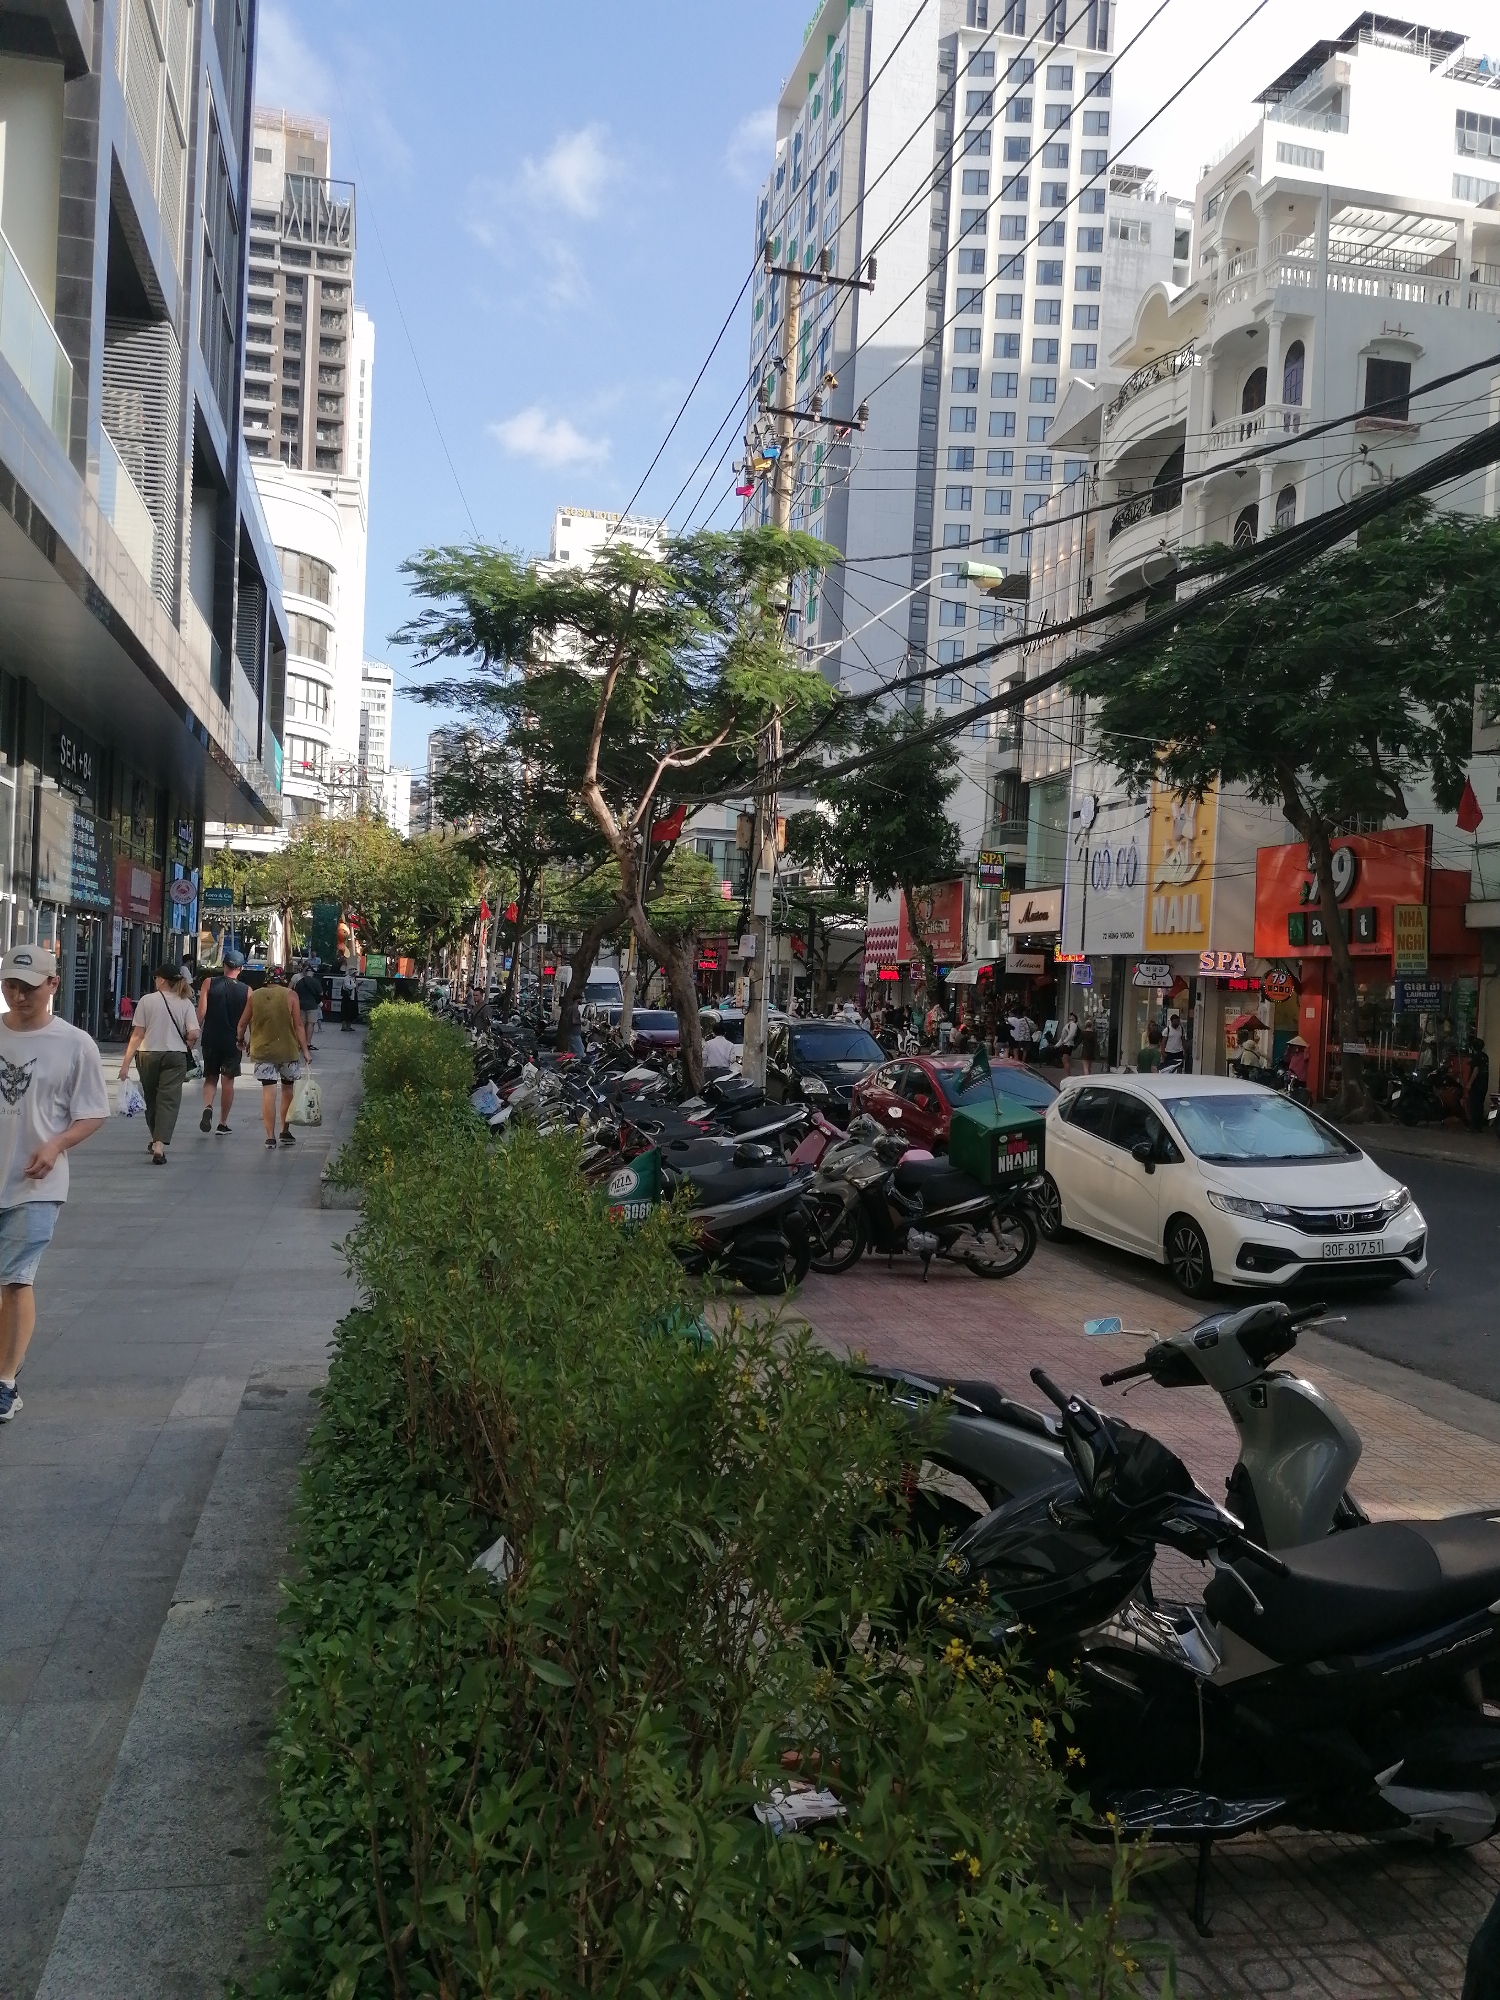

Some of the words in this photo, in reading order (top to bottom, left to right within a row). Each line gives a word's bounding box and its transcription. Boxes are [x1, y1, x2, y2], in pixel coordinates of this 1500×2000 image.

[594, 510, 621, 522] HOTEL
[60, 734, 76, 773] SEA
[79, 752, 92, 781] +84
[981, 852, 1003, 865] SPA
[1018, 901, 1049, 924] Maison
[1152, 894, 1204, 935] NAIL
[1399, 907, 1423, 928] NHÀ
[1397, 929, 1425, 951] NGHỈ
[1010, 958, 1042, 969] Maison
[1200, 952, 1246, 971] SPA
[1272, 973, 1286, 985] 79
[610, 1174, 633, 1191] PIZZA
[1325, 1241, 1381, 1257] 30F-817.51
